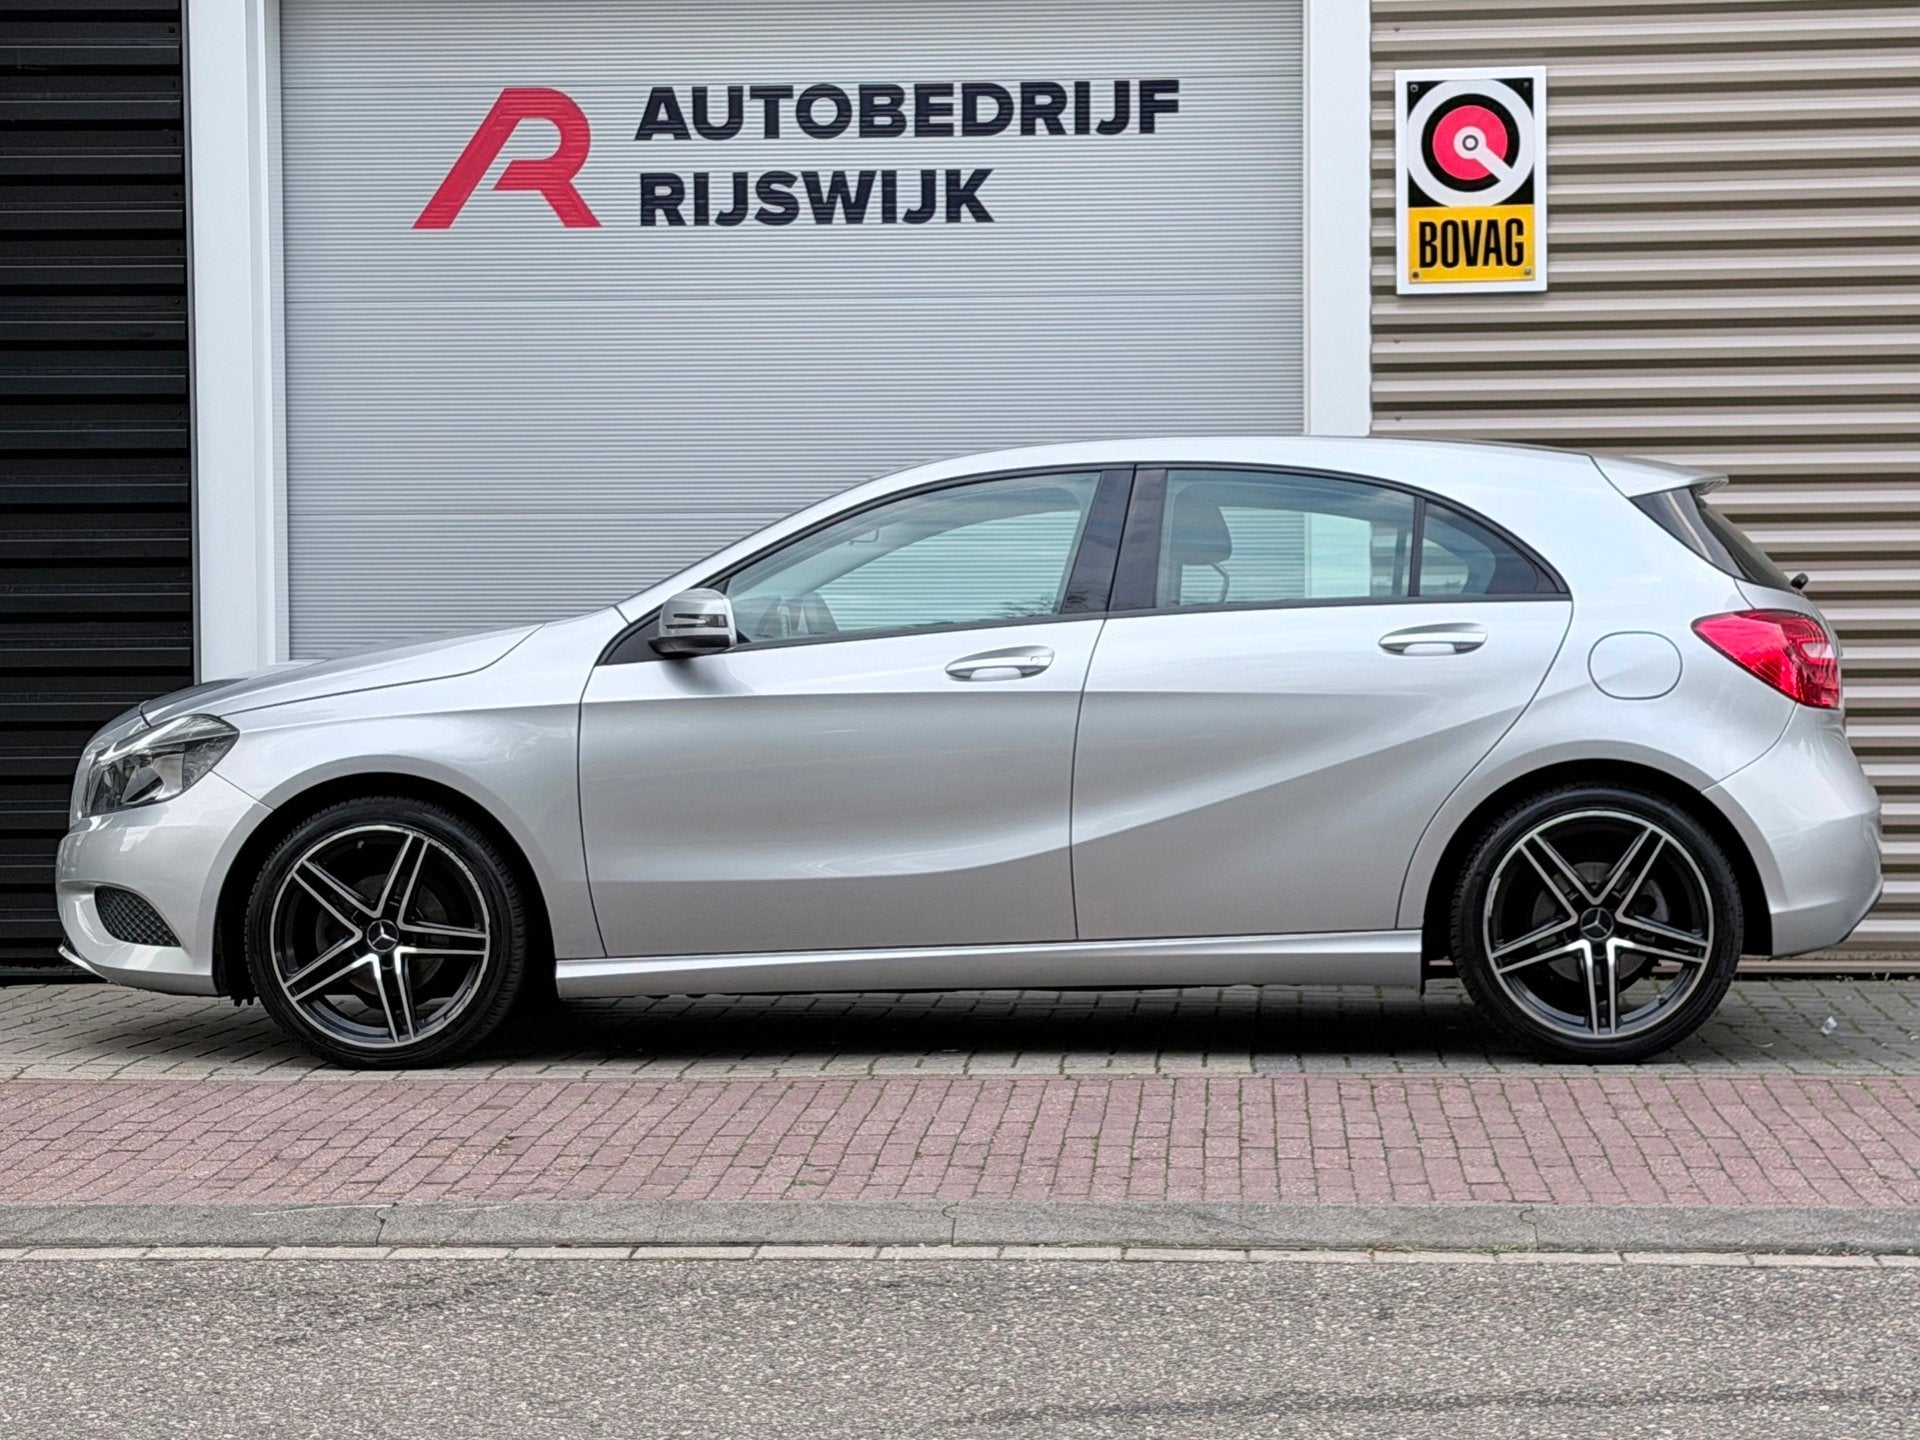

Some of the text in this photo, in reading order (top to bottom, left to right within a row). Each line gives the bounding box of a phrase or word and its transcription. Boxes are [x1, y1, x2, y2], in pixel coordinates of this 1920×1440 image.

[634, 79, 1179, 141] AUTOBEDRIJF
[640, 168, 996, 227] RIJSWIJK
[1419, 218, 1524, 269] BOVAG
